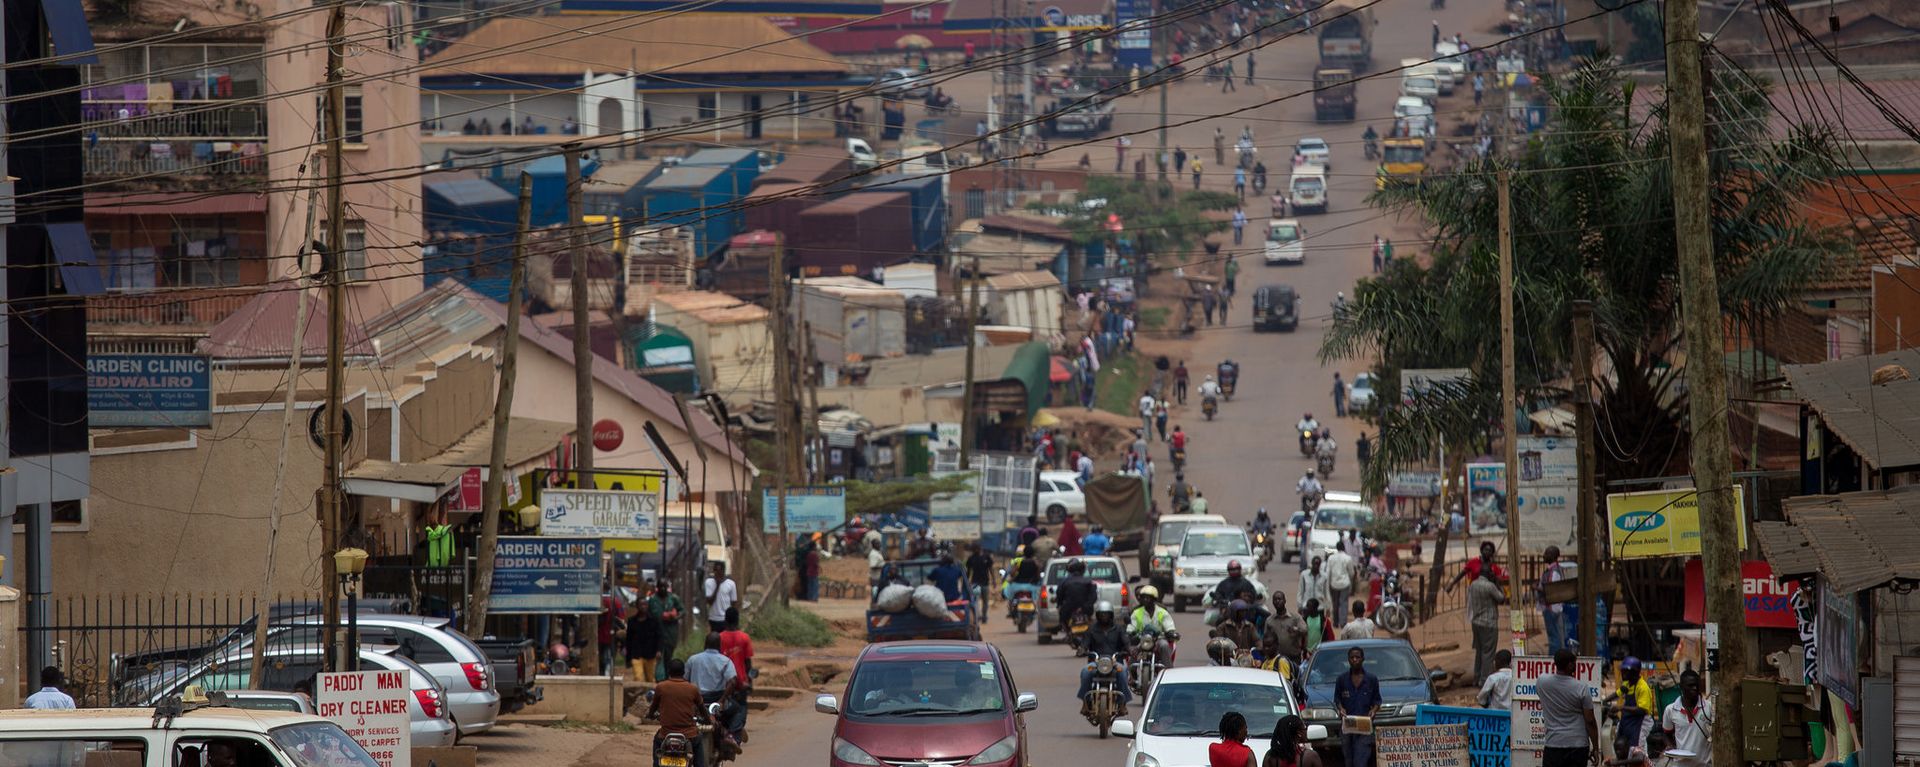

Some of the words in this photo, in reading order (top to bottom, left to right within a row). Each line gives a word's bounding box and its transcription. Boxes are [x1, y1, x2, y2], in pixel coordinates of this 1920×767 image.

[87, 359, 141, 373] ARDEN
[148, 359, 205, 373] CLINIC
[87, 375, 193, 388] EDDWALIRO
[565, 493, 612, 511] SPEED
[618, 494, 657, 512] WAYS
[592, 510, 632, 527] GARAGE
[1624, 514, 1657, 528] MTN
[1643, 537, 1669, 546] Available
[496, 543, 543, 555] ARDEN
[548, 543, 596, 555] CLINIC
[494, 557, 586, 568] EDDWALIRO
[1743, 574, 1789, 595] ari
[1744, 596, 1790, 613] esa
[324, 673, 365, 692] PADDY
[377, 672, 403, 690] MAN
[320, 701, 344, 718] DRY
[350, 699, 407, 716] CLEANER
[345, 728, 365, 737] NDRY
[367, 727, 400, 735] SERVICES
[371, 737, 401, 747] CARPET
